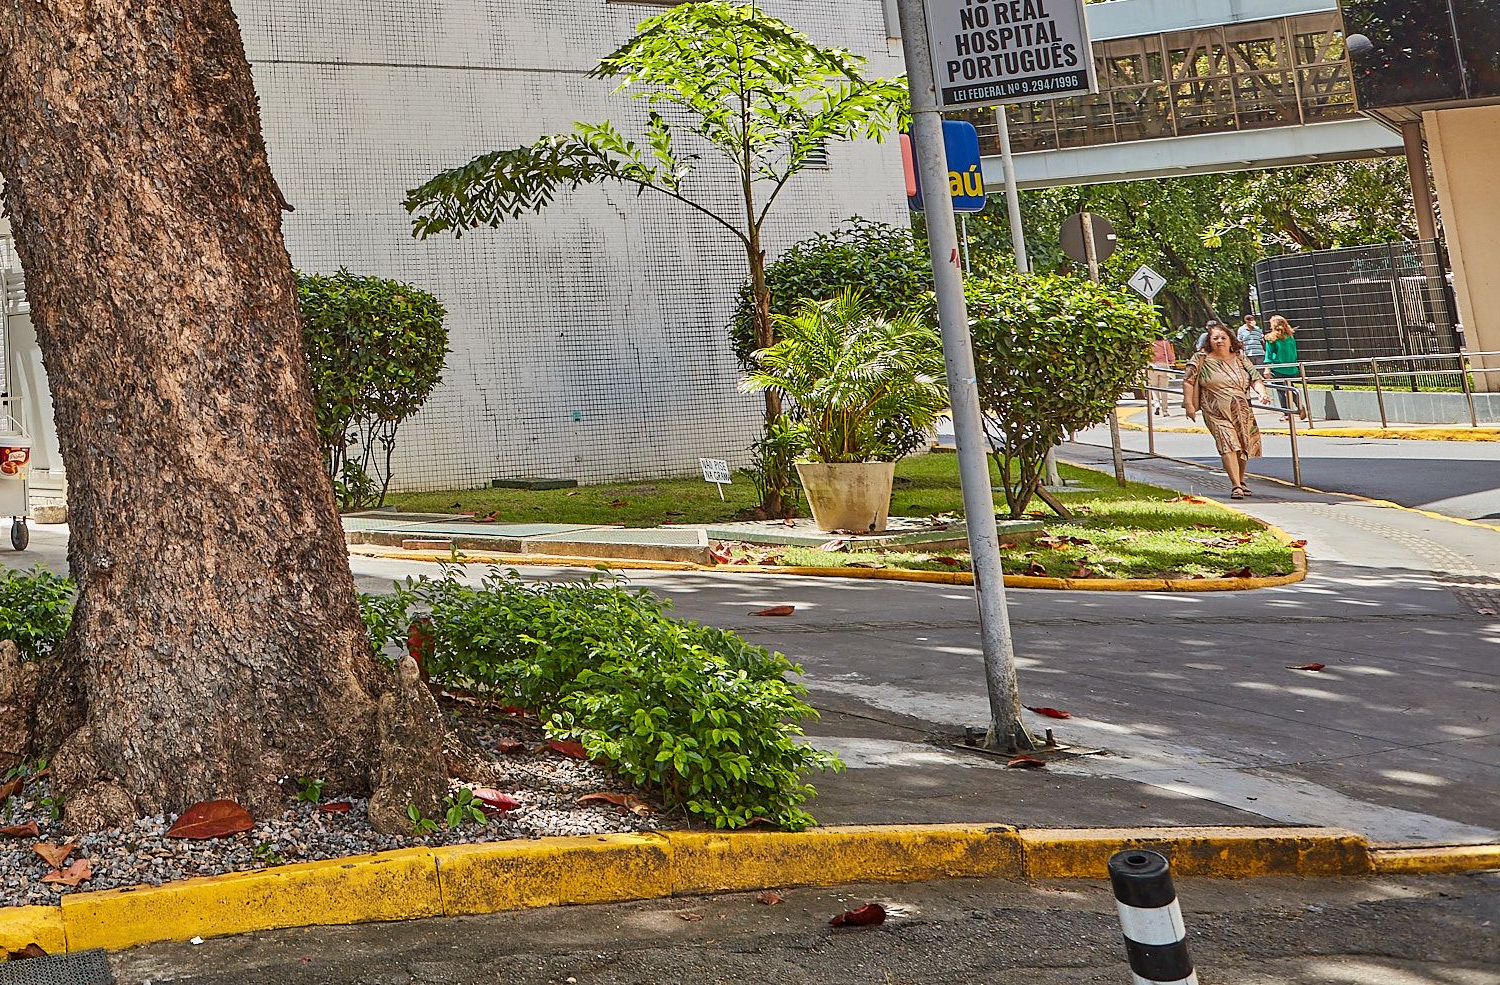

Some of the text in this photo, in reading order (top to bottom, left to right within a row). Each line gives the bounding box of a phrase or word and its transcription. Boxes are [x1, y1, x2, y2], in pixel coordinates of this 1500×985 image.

[960, 5, 989, 30] NO
[955, 20, 1062, 57] HOSPITAL
[946, 42, 1078, 83] PORTUGUÊS
[953, 88, 967, 102] LEI
[968, 83, 1006, 100] FEDERAL
[1022, 75, 1078, 93] 9.294/1996
[948, 164, 983, 197] aú
